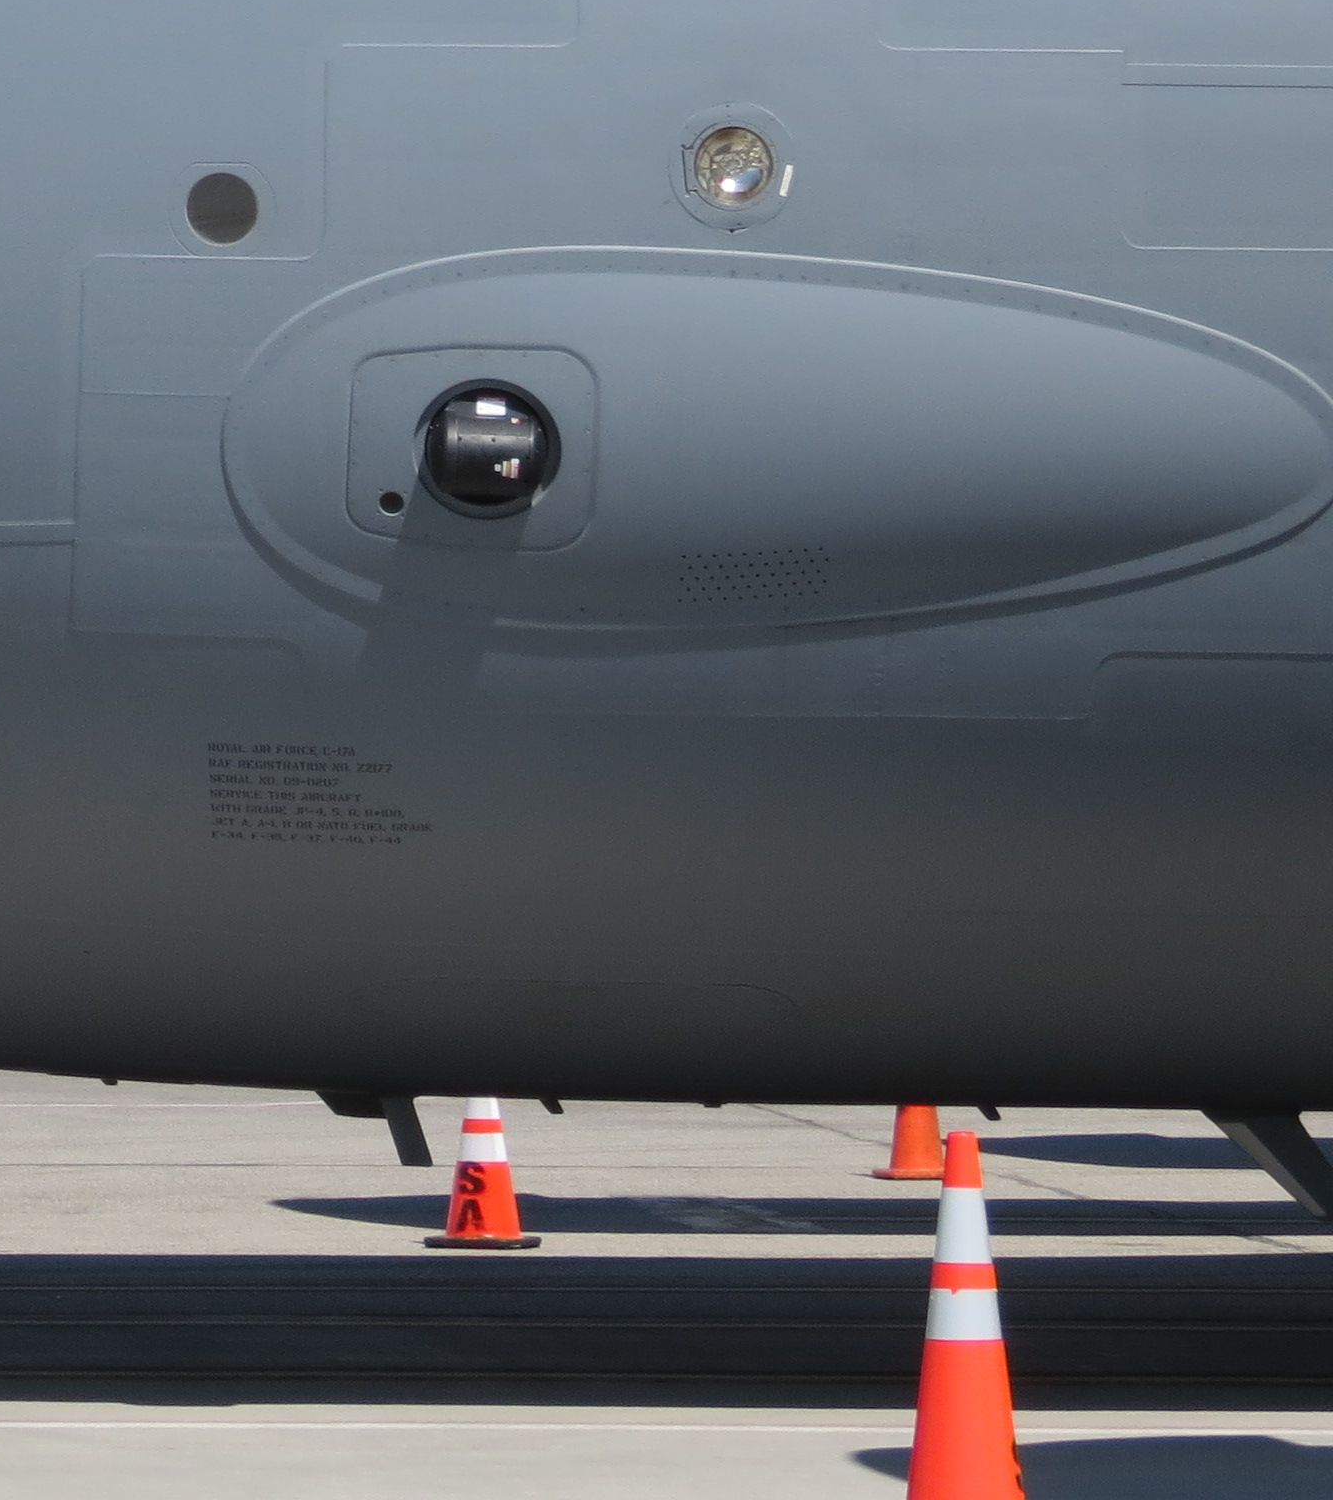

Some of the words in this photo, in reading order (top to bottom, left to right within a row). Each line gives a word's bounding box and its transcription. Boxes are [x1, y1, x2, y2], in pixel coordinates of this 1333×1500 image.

[207, 742, 248, 754] ROYAL
[252, 744, 271, 754] AIR
[276, 745, 317, 756] FORCE
[208, 758, 231, 768] RAF
[237, 760, 327, 772] REGISTRATION
[209, 774, 253, 785] SERIAL
[210, 789, 262, 800] SERVICE
[267, 790, 296, 801] THIS
[301, 792, 362, 803] AIRCRAFT
